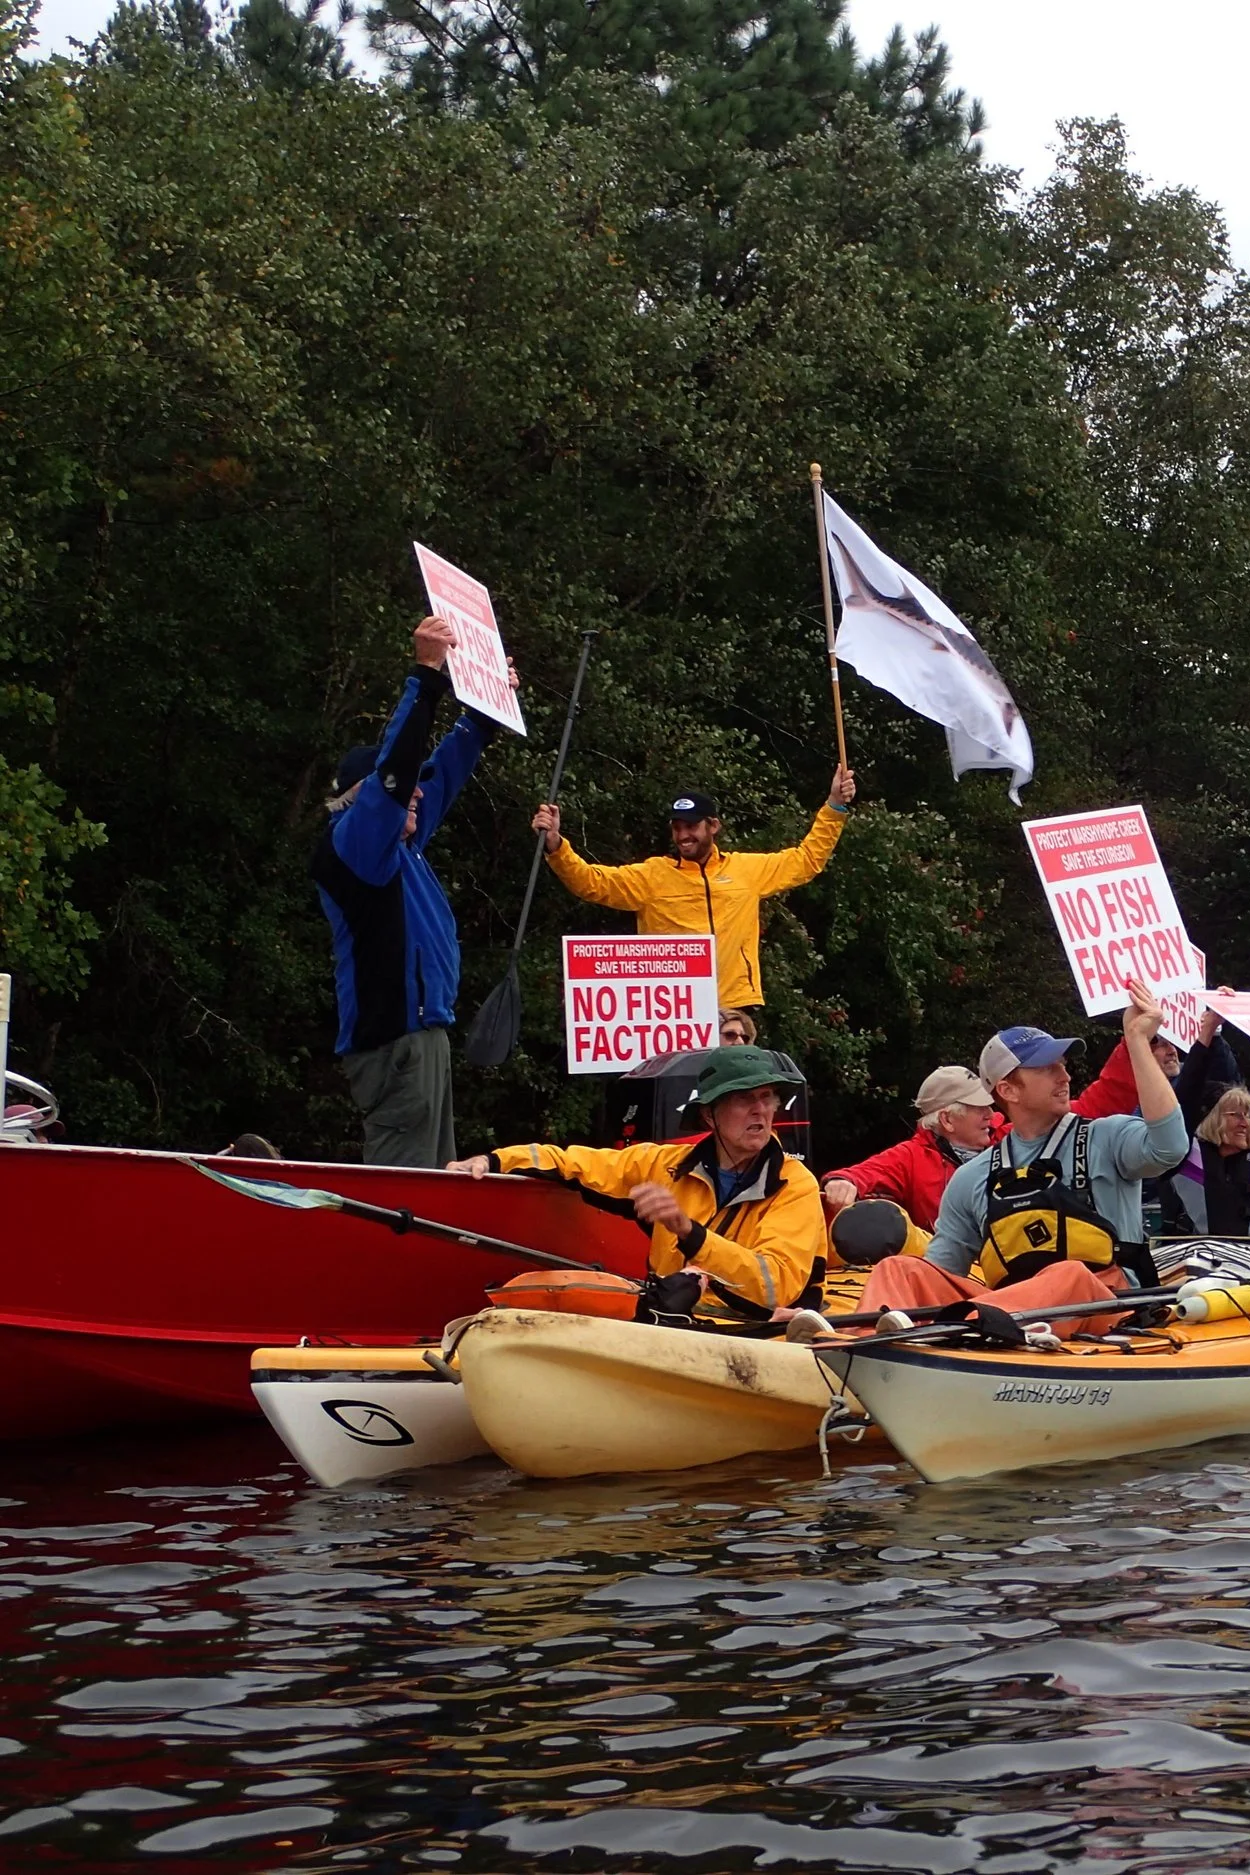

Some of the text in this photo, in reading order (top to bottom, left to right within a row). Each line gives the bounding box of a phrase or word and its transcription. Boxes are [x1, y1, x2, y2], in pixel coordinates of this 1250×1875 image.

[461, 618, 500, 673] FISH
[450, 652, 518, 721] FACTORY
[1035, 829, 1072, 851] PROTECT
[1118, 817, 1143, 837] CREEK
[1061, 843, 1136, 872] SAVE THE STURGEON
[1055, 876, 1161, 942] NO FISH
[573, 943, 706, 957] PROTECT MARSHYHOPE CREEK
[595, 960, 686, 974] SAVE THE STURGEON
[1074, 926, 1190, 999] FACTORY
[572, 985, 693, 1022] NO FISH
[575, 1023, 713, 1062] FACTORY
[993, 1382, 1087, 1405] MANITOU
